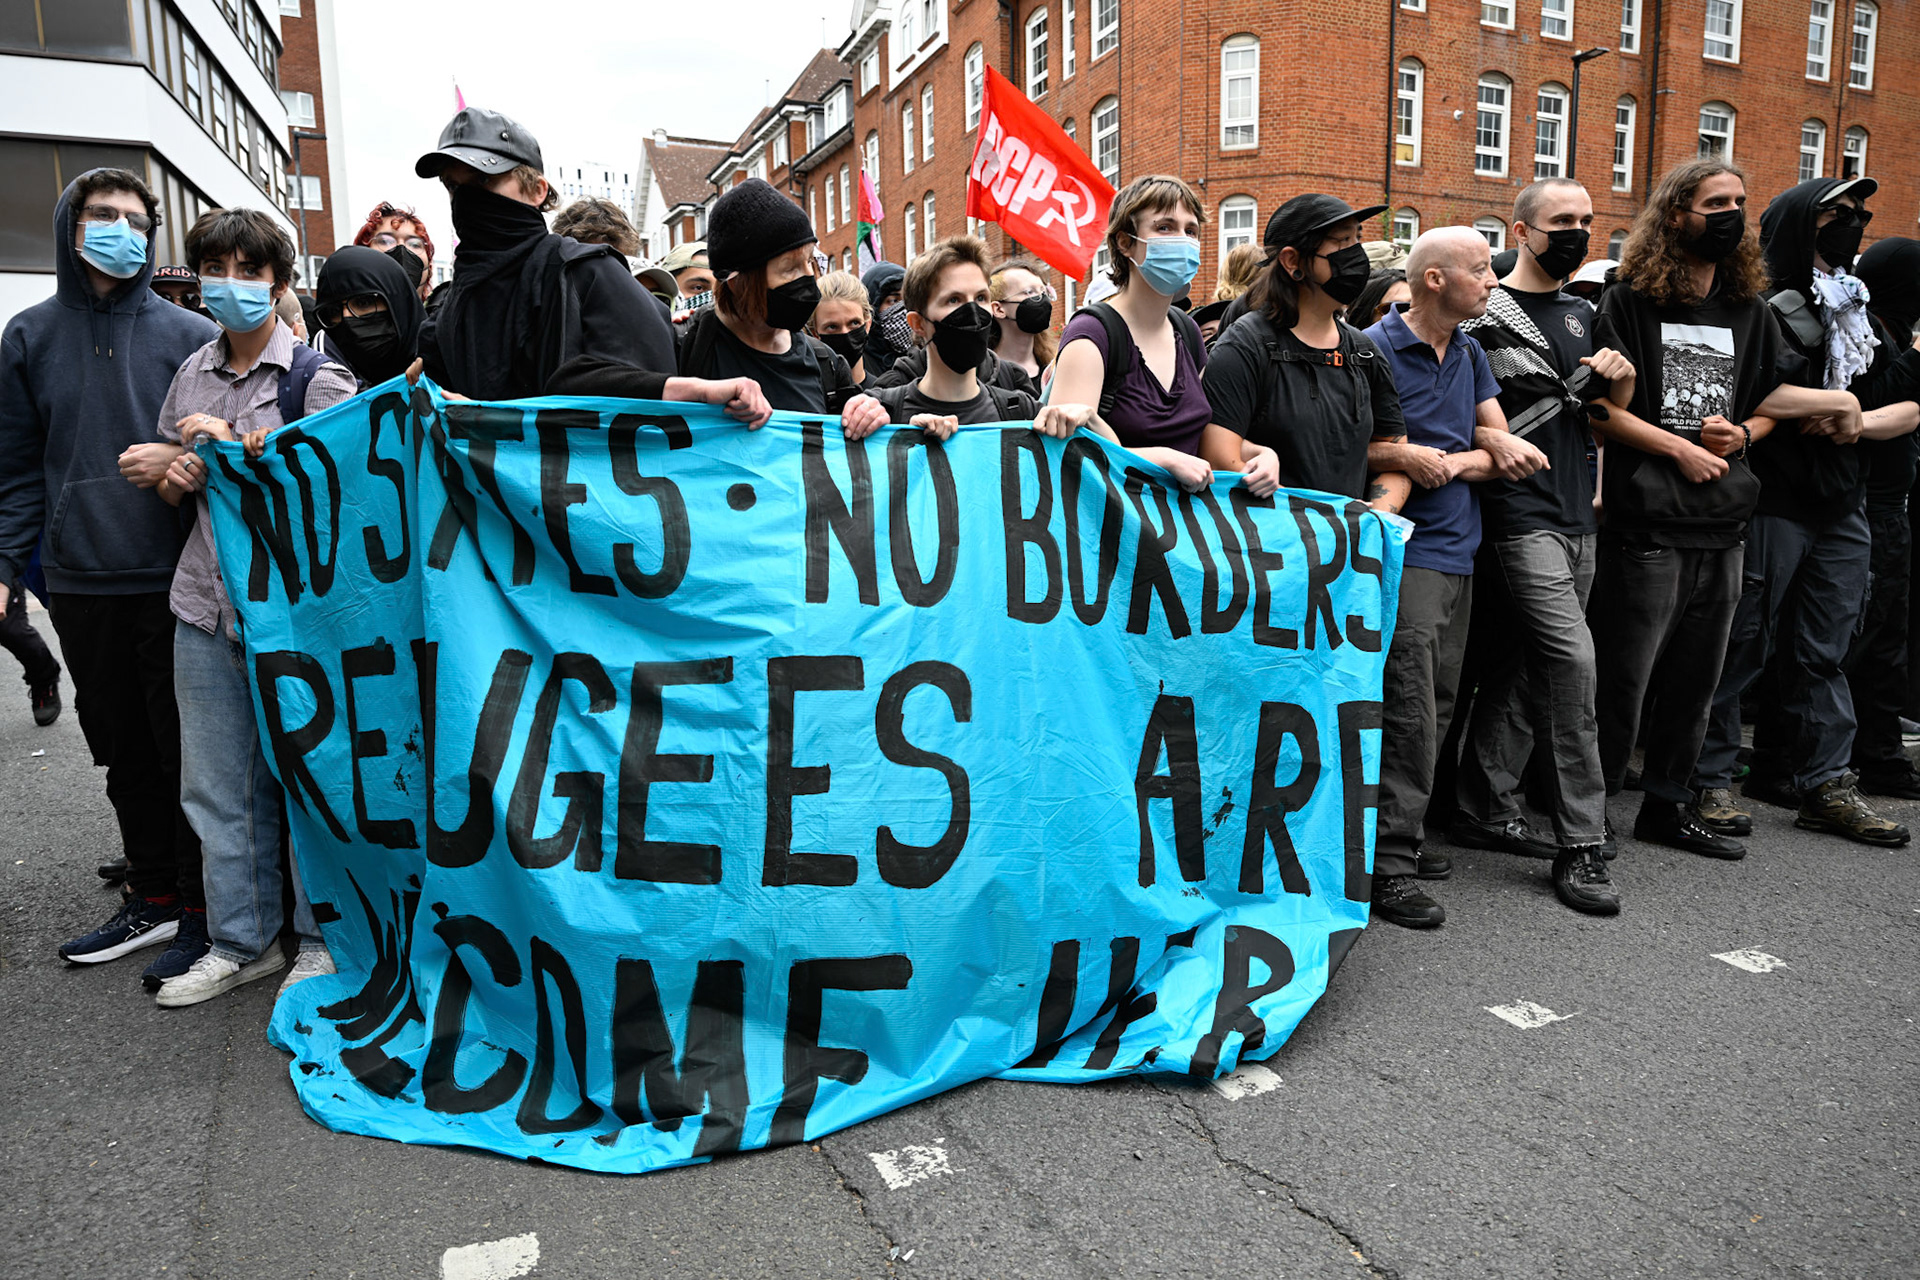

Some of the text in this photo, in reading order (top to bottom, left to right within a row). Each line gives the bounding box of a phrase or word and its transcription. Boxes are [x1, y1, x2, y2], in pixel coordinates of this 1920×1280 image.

[972, 110, 1058, 215] RCP
[218, 428, 341, 605] NO
[802, 420, 960, 608] NO
[1001, 428, 1384, 653] BORDERS
[255, 636, 1384, 903] REUGEES ARE
